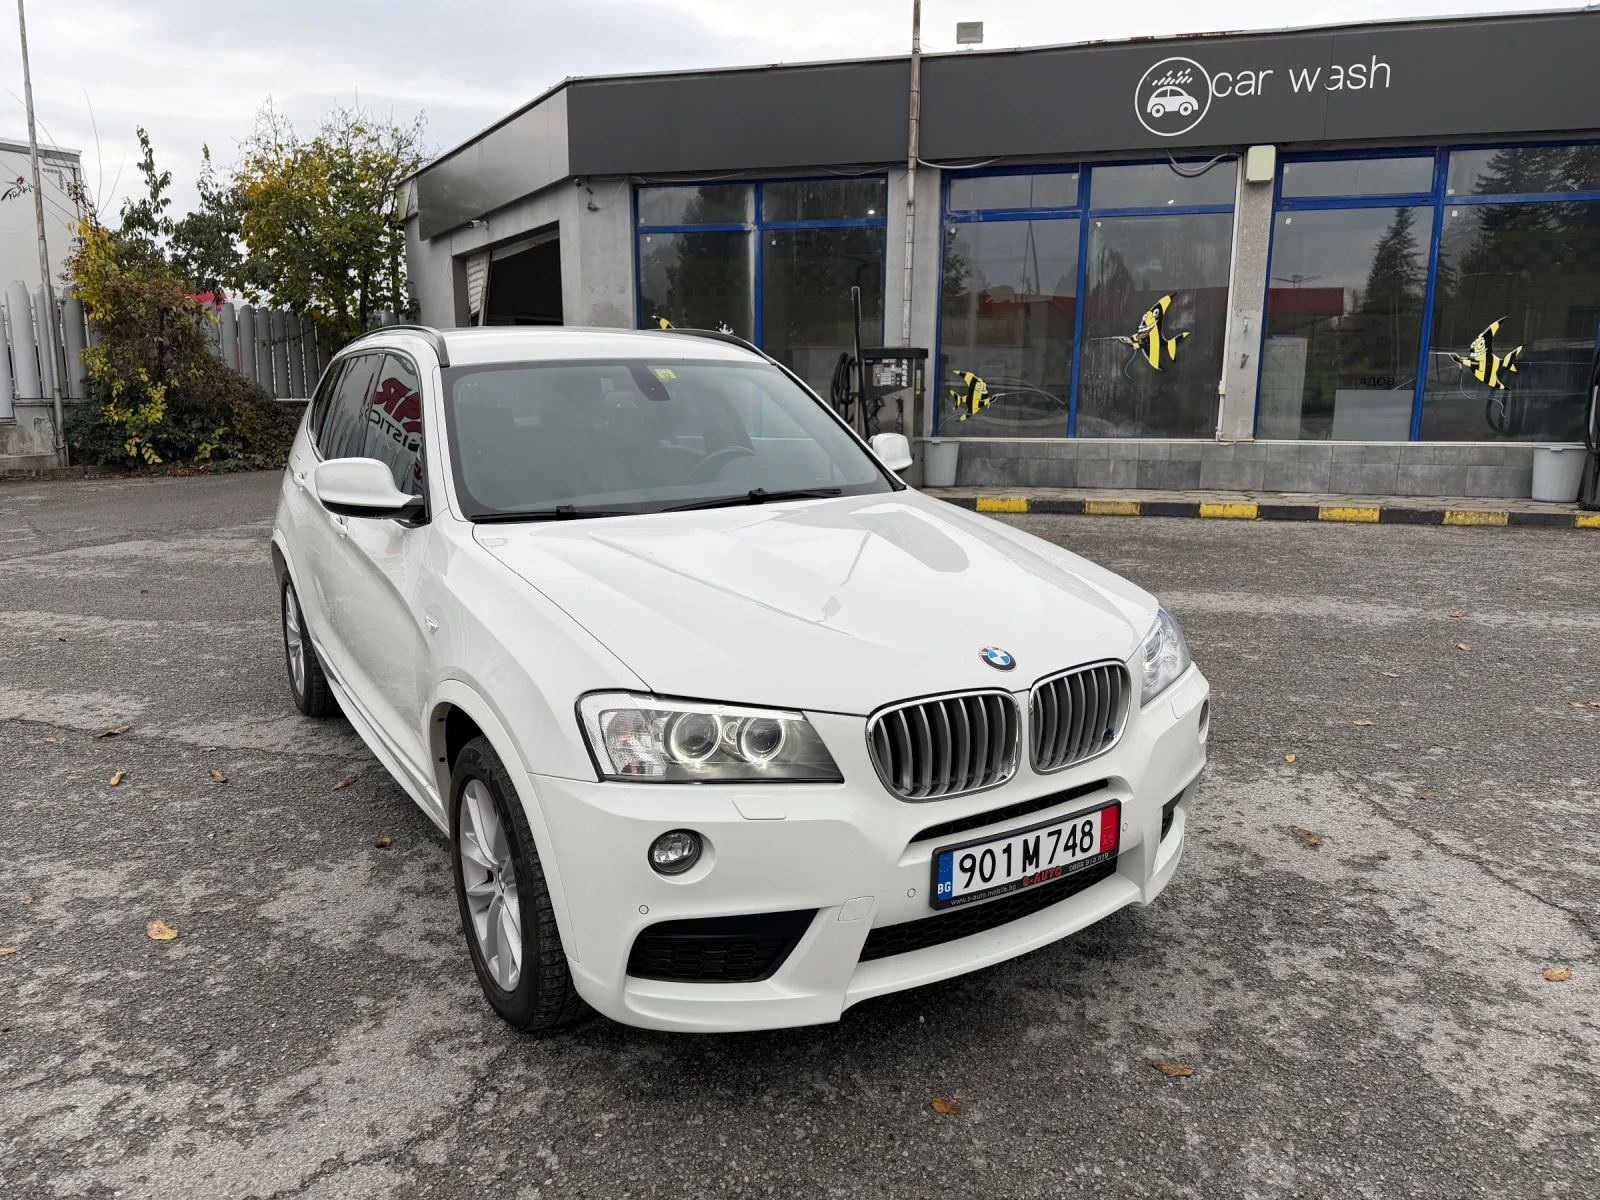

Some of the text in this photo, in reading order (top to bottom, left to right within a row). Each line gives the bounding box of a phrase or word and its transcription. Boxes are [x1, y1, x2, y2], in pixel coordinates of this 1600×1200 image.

[1212, 54, 1391, 97] car wash
[1021, 865, 1063, 887] S-AUTO
[937, 883, 951, 895] BG
